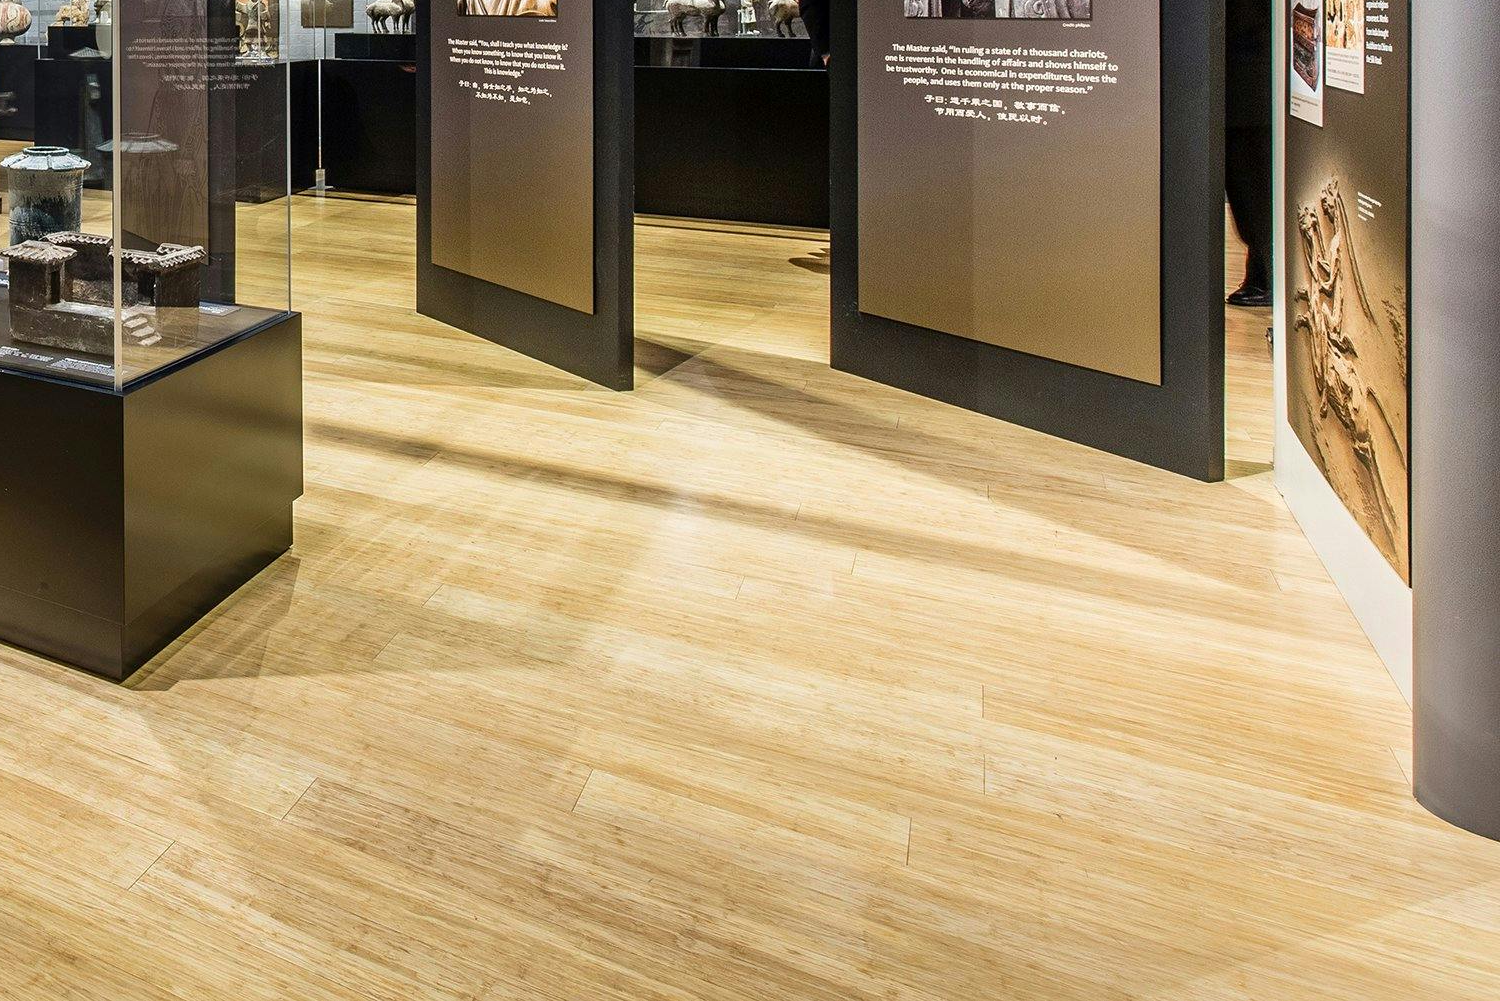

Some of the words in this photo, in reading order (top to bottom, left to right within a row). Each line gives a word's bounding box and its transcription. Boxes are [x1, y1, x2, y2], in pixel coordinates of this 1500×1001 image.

[906, 44, 930, 52] Master
[931, 45, 948, 54] said,
[962, 46, 984, 56] ruling
[1012, 47, 1021, 55] of
[1029, 48, 1068, 57] thousand
[1070, 49, 1107, 60] chariots,
[944, 56, 956, 64] the
[958, 57, 990, 68] handling
[992, 58, 1000, 66] of
[1002, 59, 1026, 67] affairs
[1028, 60, 1043, 68] and
[1045, 60, 1072, 69] shows
[1074, 61, 1106, 70] himself
[1108, 63, 1118, 71] to
[896, 66, 938, 75] trustworthy.
[941, 67, 956, 75] One
[1009, 70, 1017, 78] in
[1018, 72, 1075, 83] expenditures,
[1077, 73, 1100, 82] loves
[1101, 75, 1117, 83] the
[904, 77, 929, 85] people,
[962, 79, 982, 87] them
[983, 81, 1000, 90] only
[1011, 82, 1024, 90] the
[1026, 85, 1054, 93] proper
